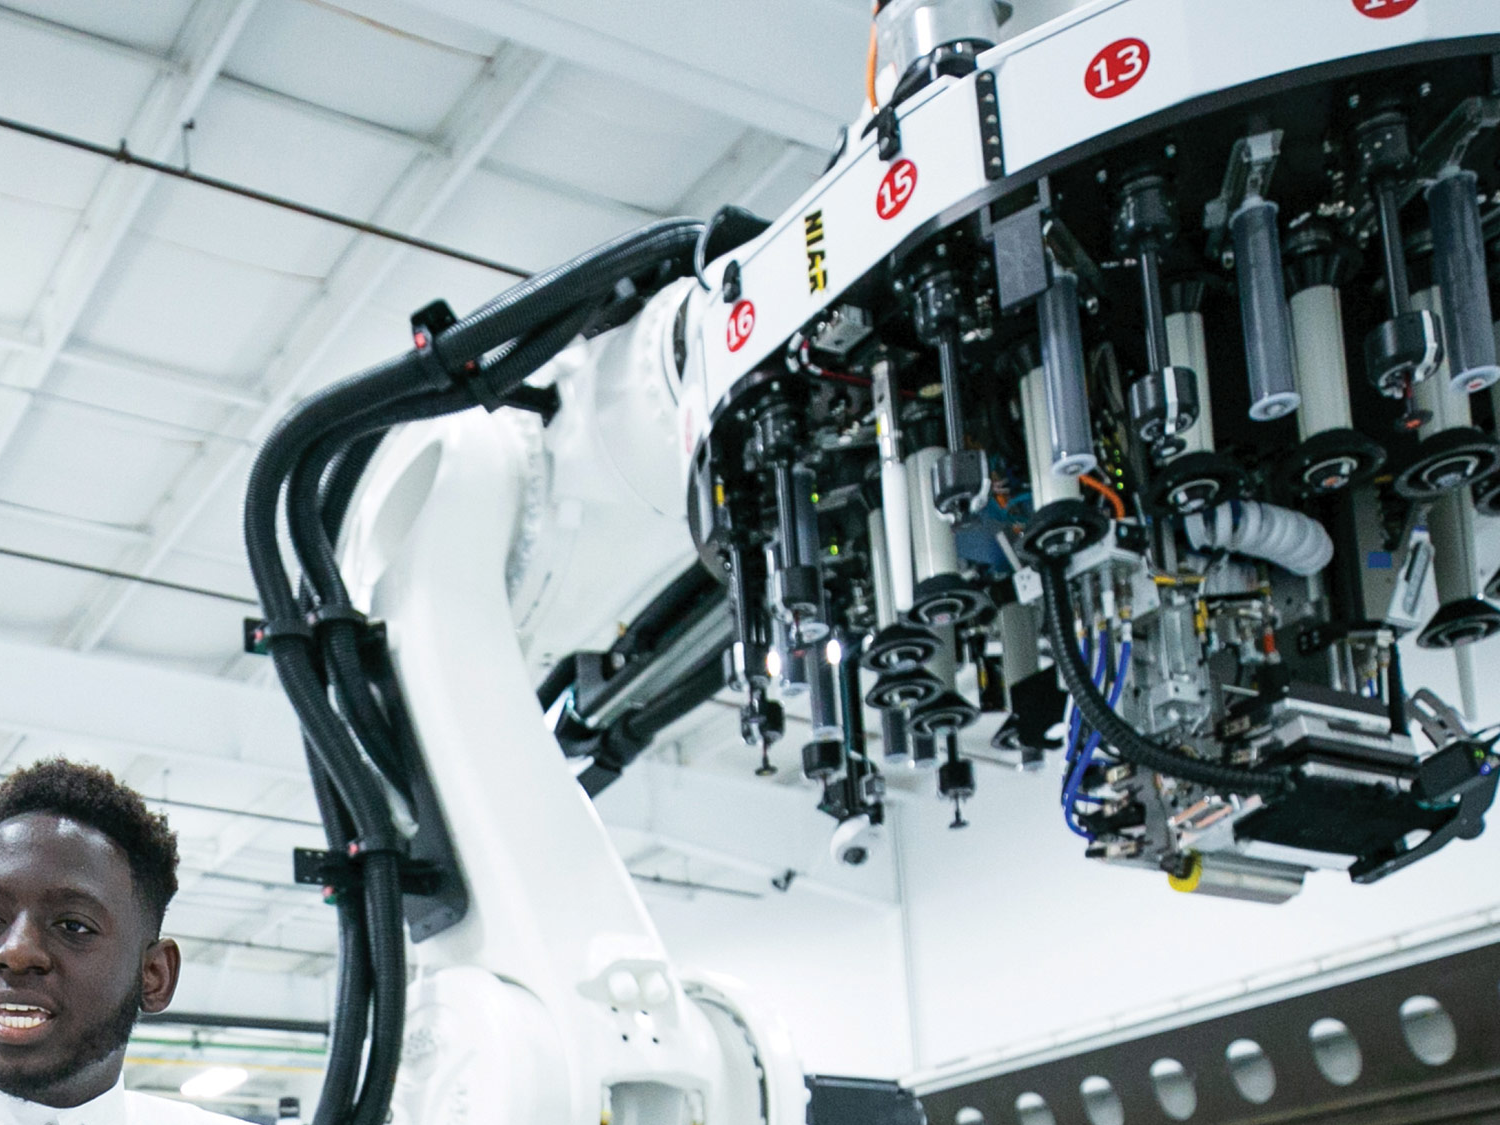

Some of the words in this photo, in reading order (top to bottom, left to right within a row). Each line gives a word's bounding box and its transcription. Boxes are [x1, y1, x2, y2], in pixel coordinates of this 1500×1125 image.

[1092, 45, 1143, 93] 13
[879, 163, 913, 216] 15
[804, 209, 828, 295] NIAR
[727, 303, 755, 349] 16
